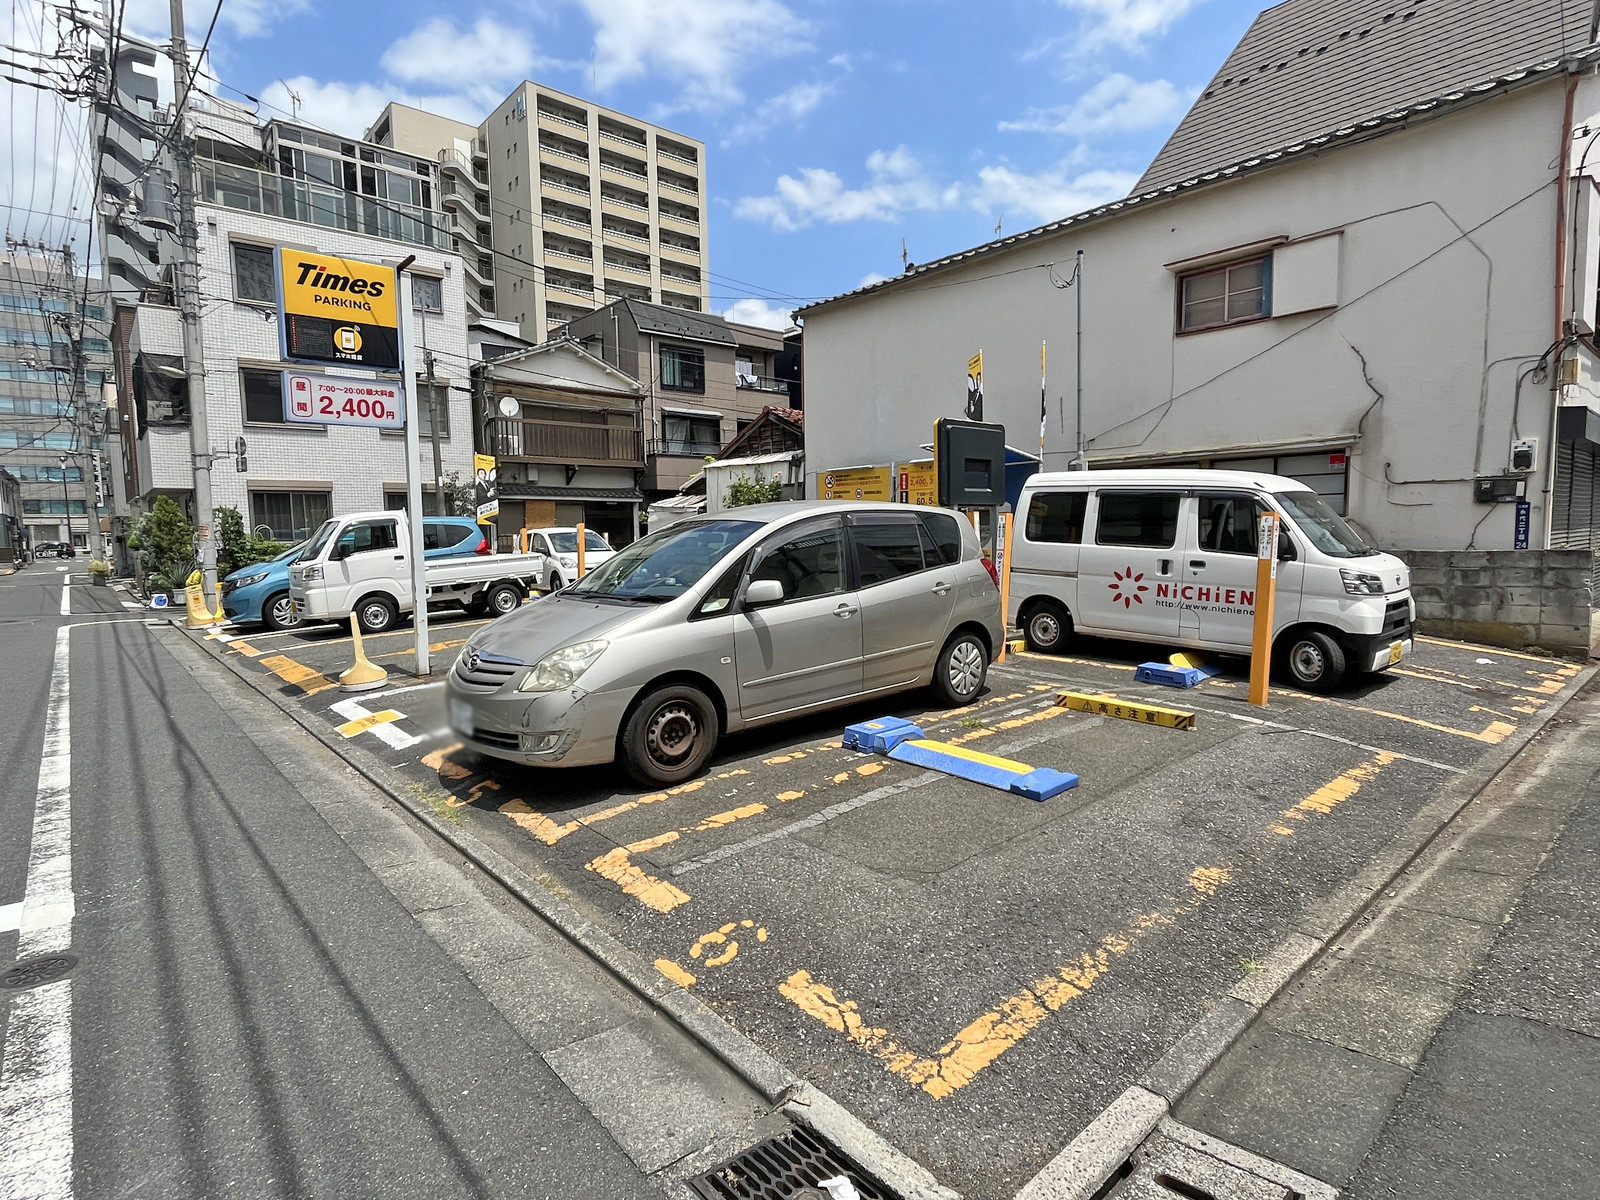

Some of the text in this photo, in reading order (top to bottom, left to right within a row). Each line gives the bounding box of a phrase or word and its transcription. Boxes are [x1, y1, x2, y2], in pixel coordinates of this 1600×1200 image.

[296, 262, 386, 298] Times
[314, 294, 372, 311] PARKING
[319, 395, 395, 419] 2,400円
[1515, 541, 1527, 549] 24
[1098, 703, 1158, 723] 高さ注意
